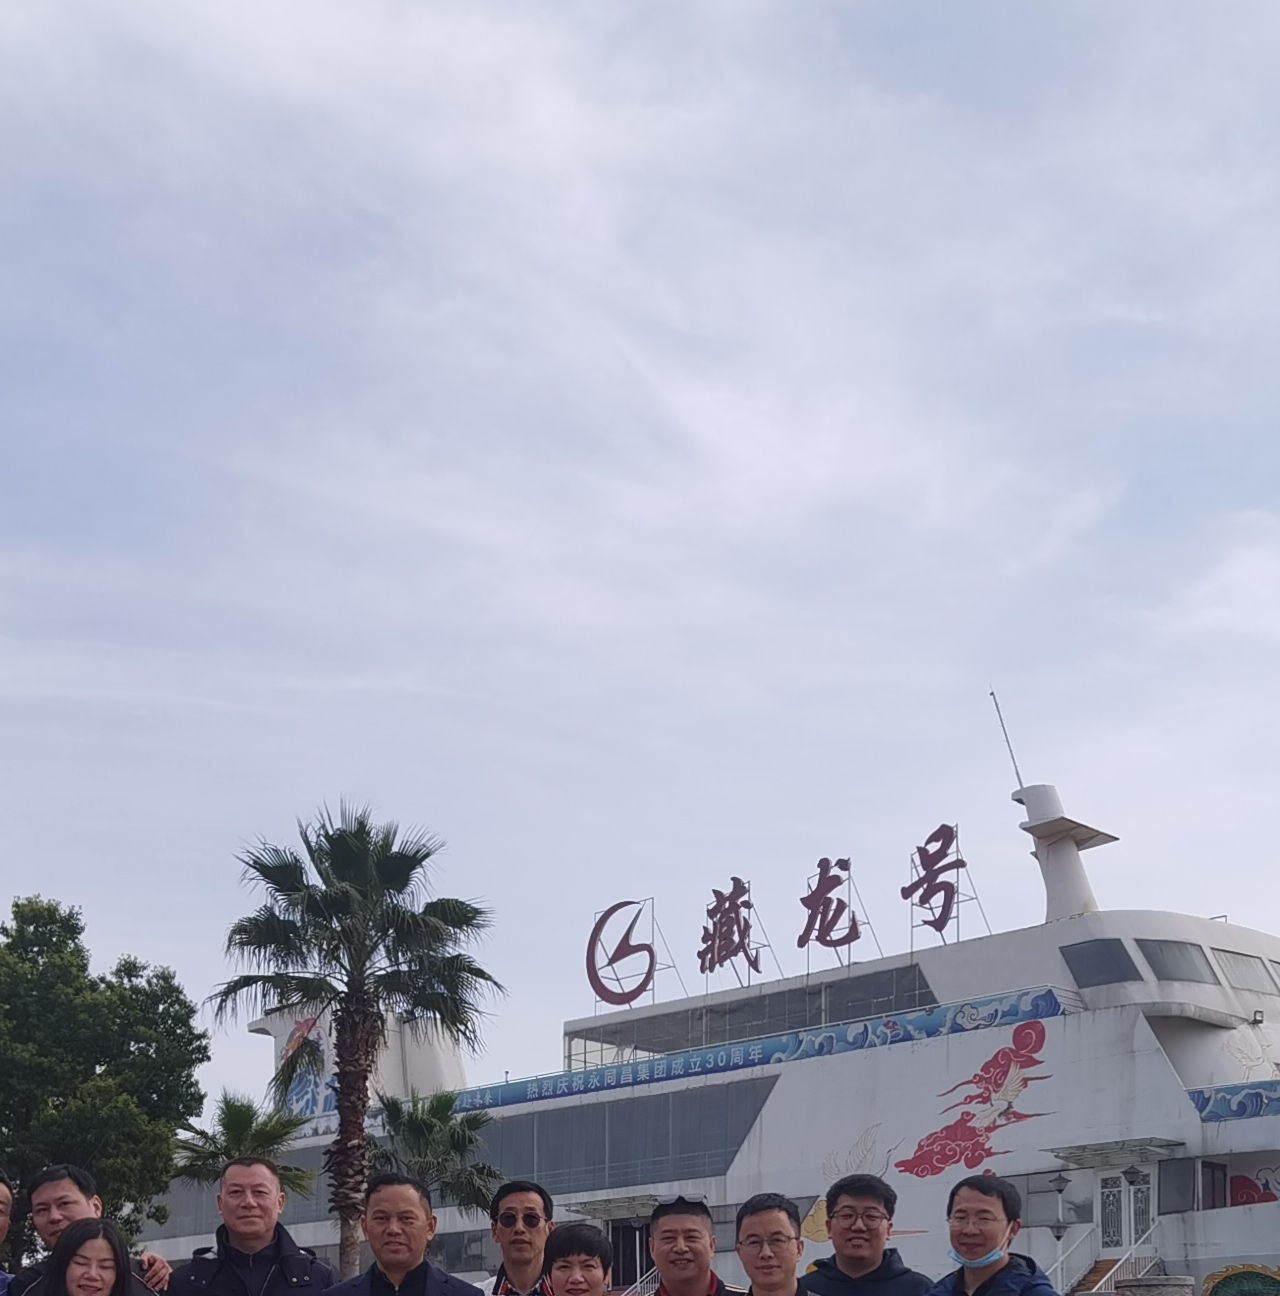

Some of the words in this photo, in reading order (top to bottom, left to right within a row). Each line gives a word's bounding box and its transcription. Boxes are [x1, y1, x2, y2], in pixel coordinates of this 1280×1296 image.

[697, 823, 967, 974] 藏龙号
[526, 1043, 763, 1099] 热烈庆祝永同昌集团成立30周年
